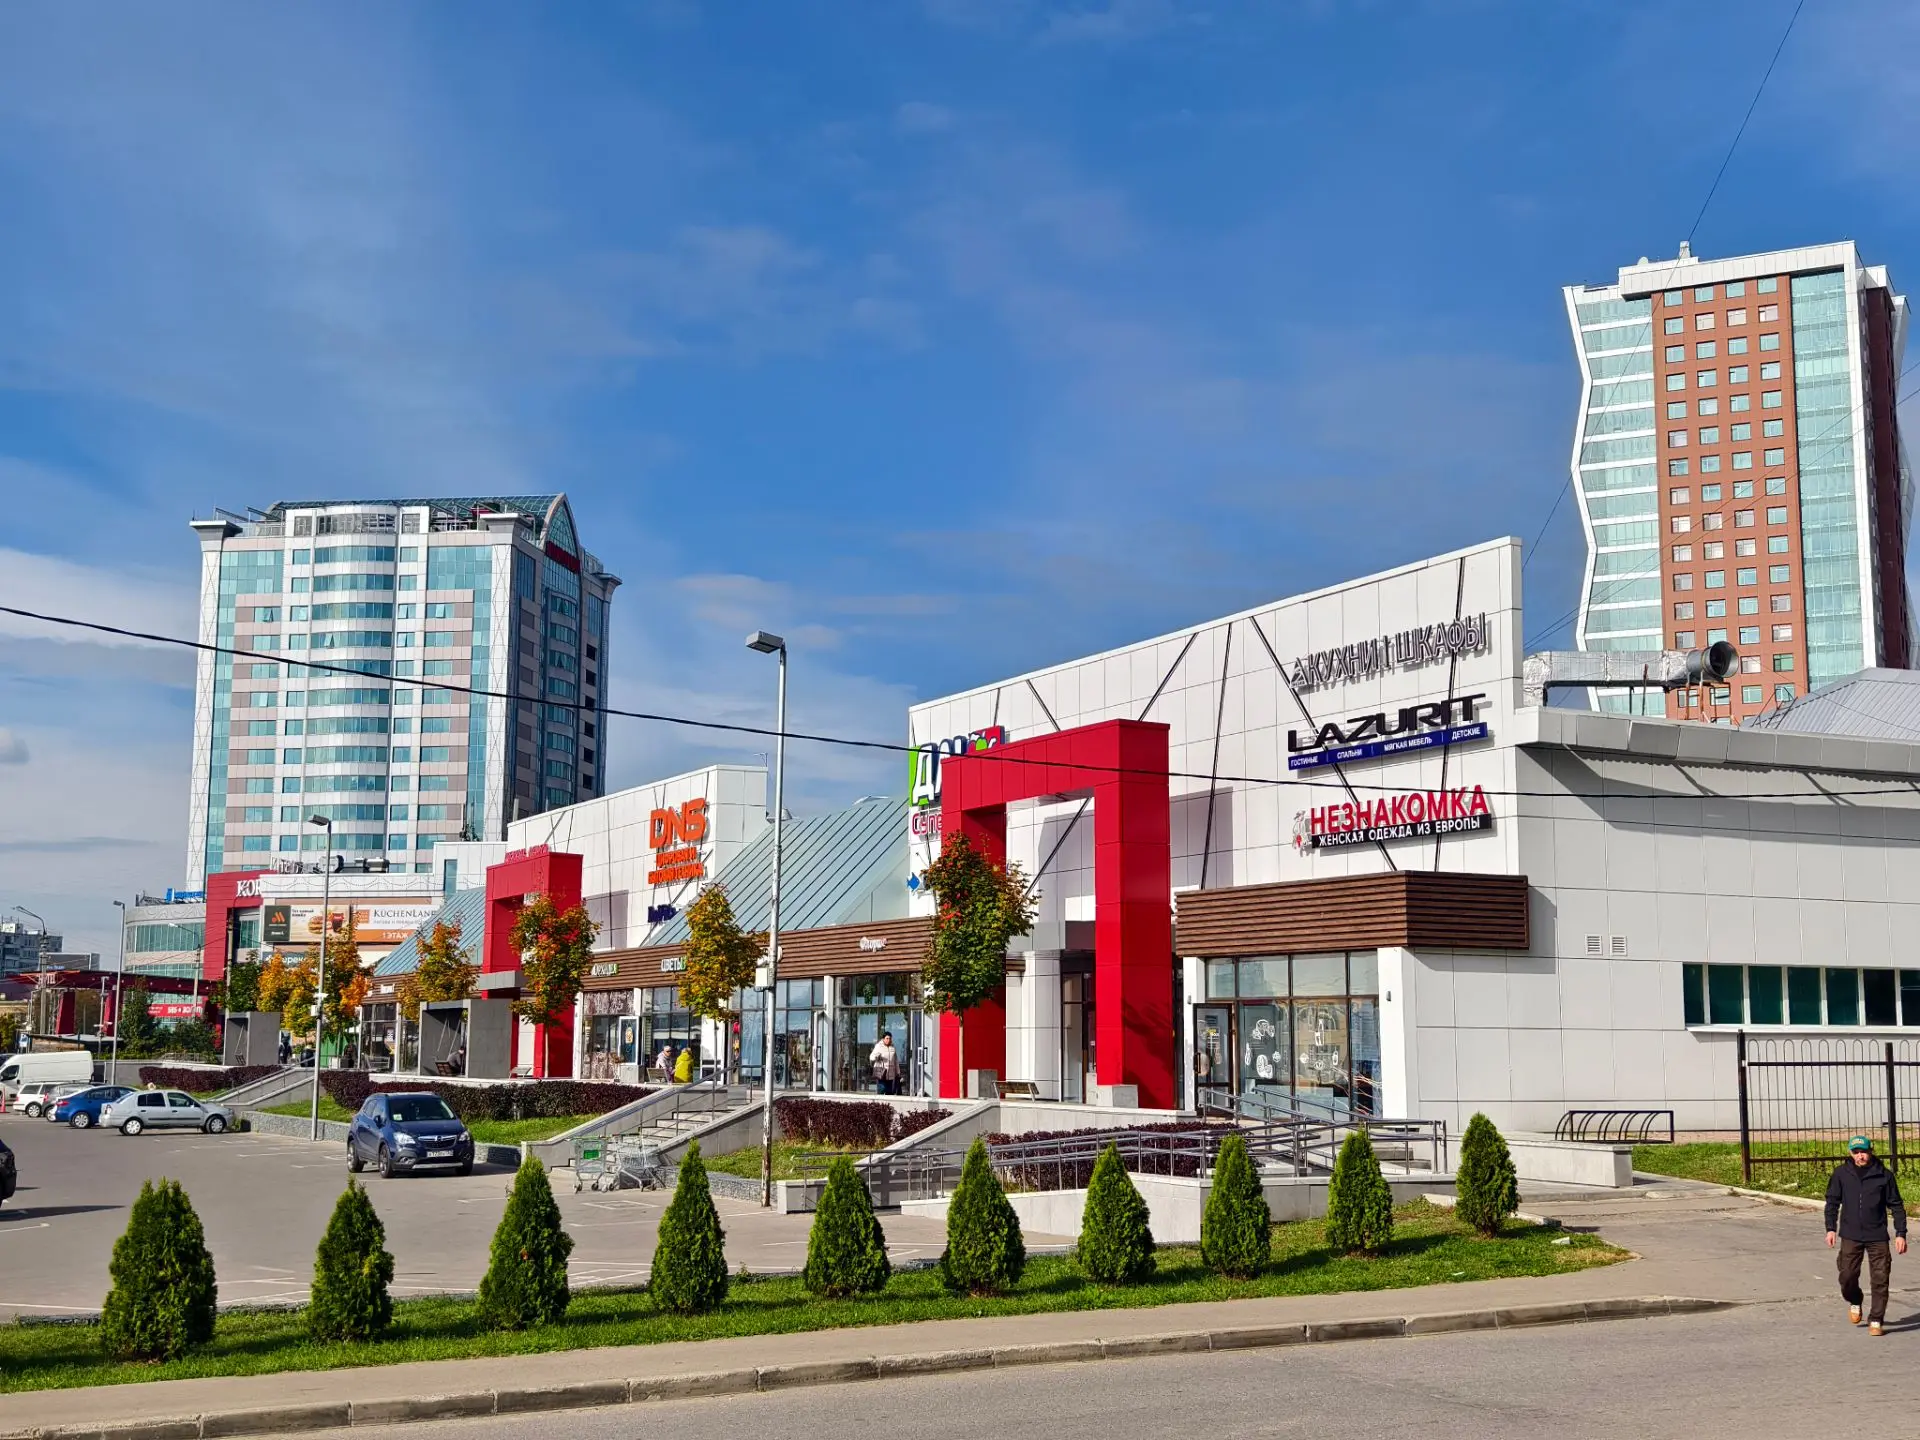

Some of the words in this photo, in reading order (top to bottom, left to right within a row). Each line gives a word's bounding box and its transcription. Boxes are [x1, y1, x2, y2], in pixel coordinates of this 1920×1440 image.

[1308, 638, 1379, 685] КУХНИ
[1395, 612, 1487, 664] ШКАФЫ
[1287, 693, 1486, 753] LAZURIT
[1290, 756, 1319, 768] ГОСТИНЫЕ
[1336, 749, 1363, 760] СПАЛЬНИ
[1384, 740, 1408, 752] МЯГКАЯ
[1408, 736, 1433, 748] МЕБЕЛЬ
[1451, 726, 1481, 741] ДЕТСКИЕ
[650, 797, 706, 849] DNS
[1311, 784, 1489, 834] НЕЗНАКОМКА
[1318, 831, 1364, 847] ЖЕНСКАЯ
[1368, 825, 1413, 842] ОДЕЖДА
[1417, 823, 1431, 836] ИЗ
[1436, 816, 1481, 834] ЕВРОПЫ
